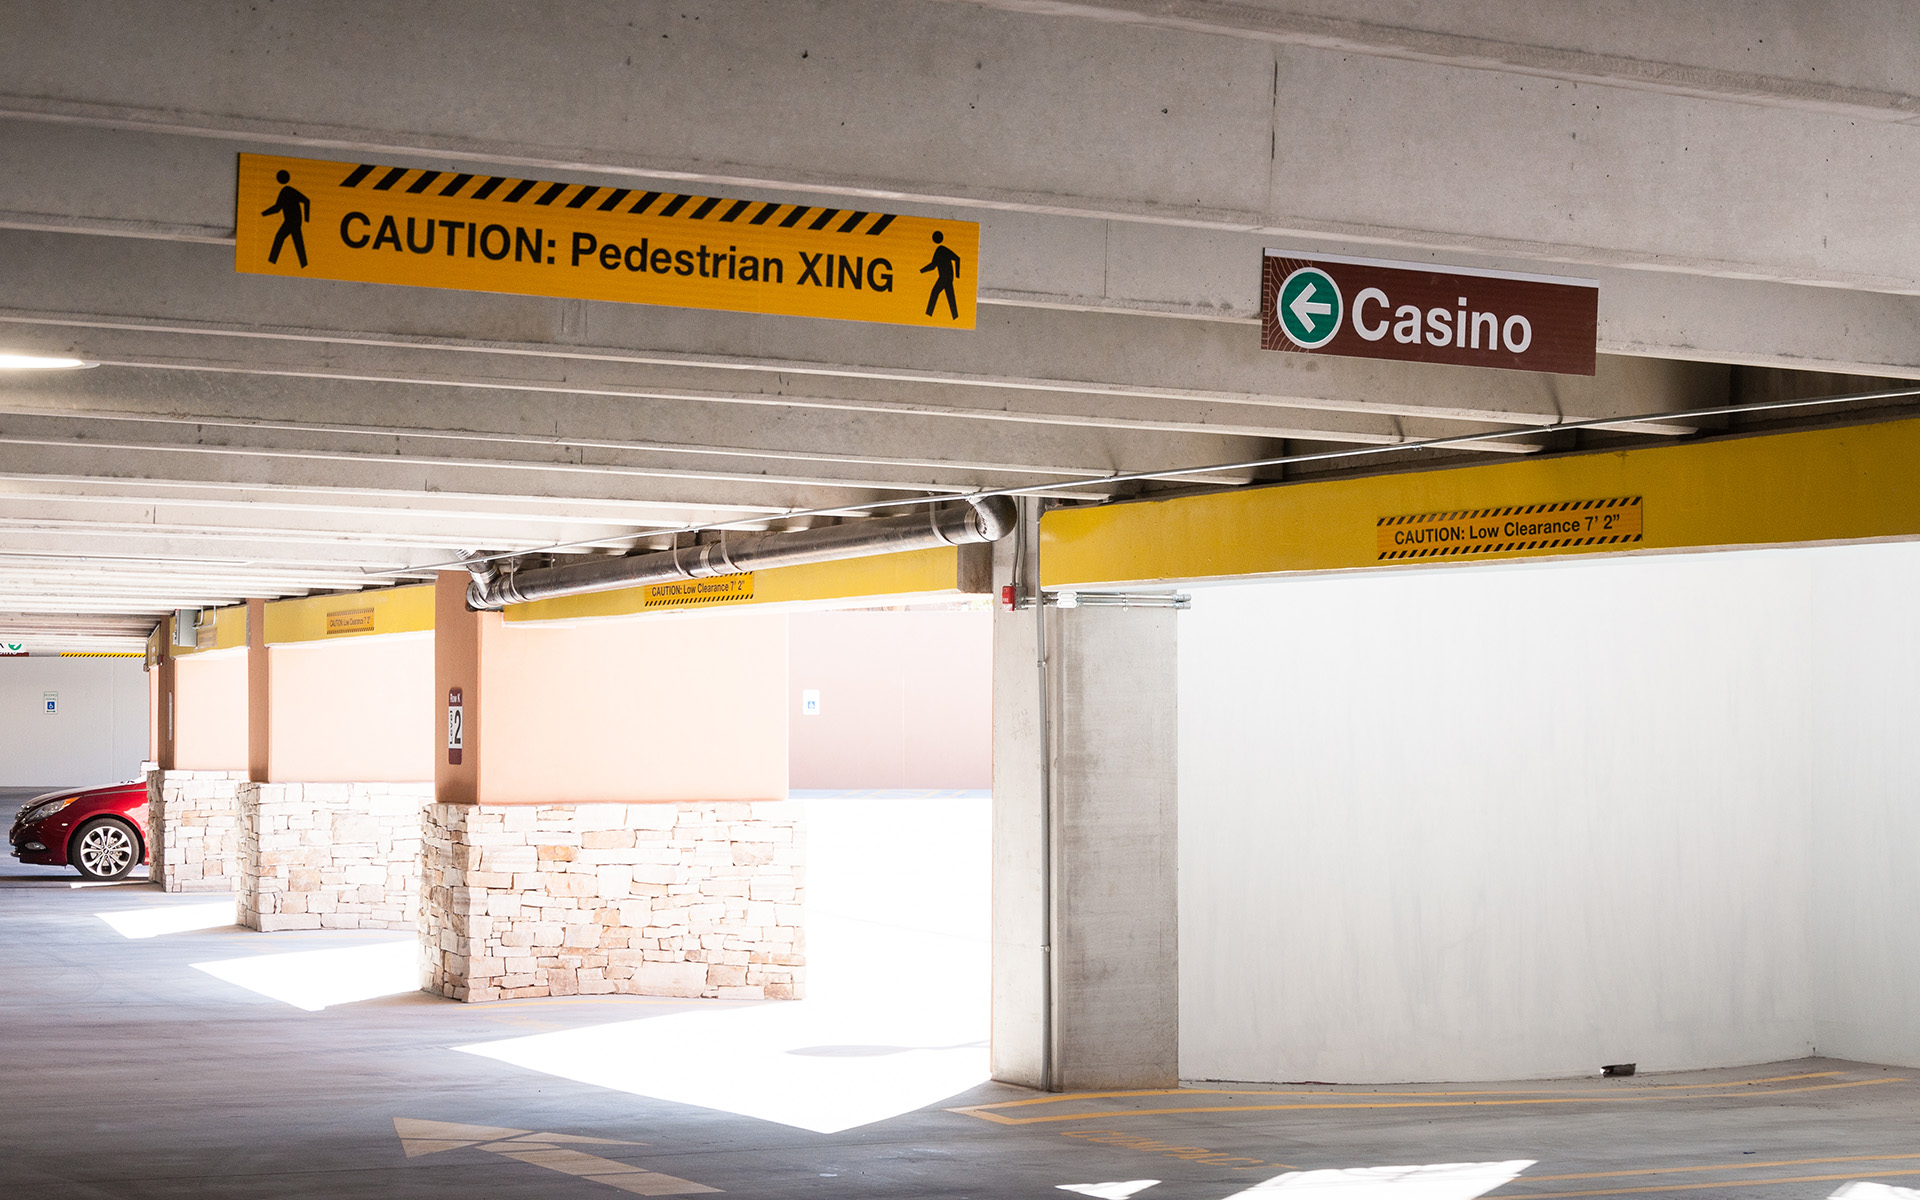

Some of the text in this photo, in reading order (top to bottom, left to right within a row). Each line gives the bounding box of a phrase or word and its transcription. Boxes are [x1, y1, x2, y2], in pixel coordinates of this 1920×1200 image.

[339, 211, 894, 293] CAUTION: Pedestrian XING
[1351, 287, 1532, 354] Casino
[1394, 527, 1465, 545] CAUTION:
[1469, 525, 1500, 540] Low
[1503, 520, 1581, 537] Clearance
[651, 585, 682, 597] CAUTION:
[683, 584, 696, 595] Low
[697, 583, 729, 594] Clearance
[454, 710, 461, 745] 2
[1059, 1129, 1298, 1170] COMPACT
